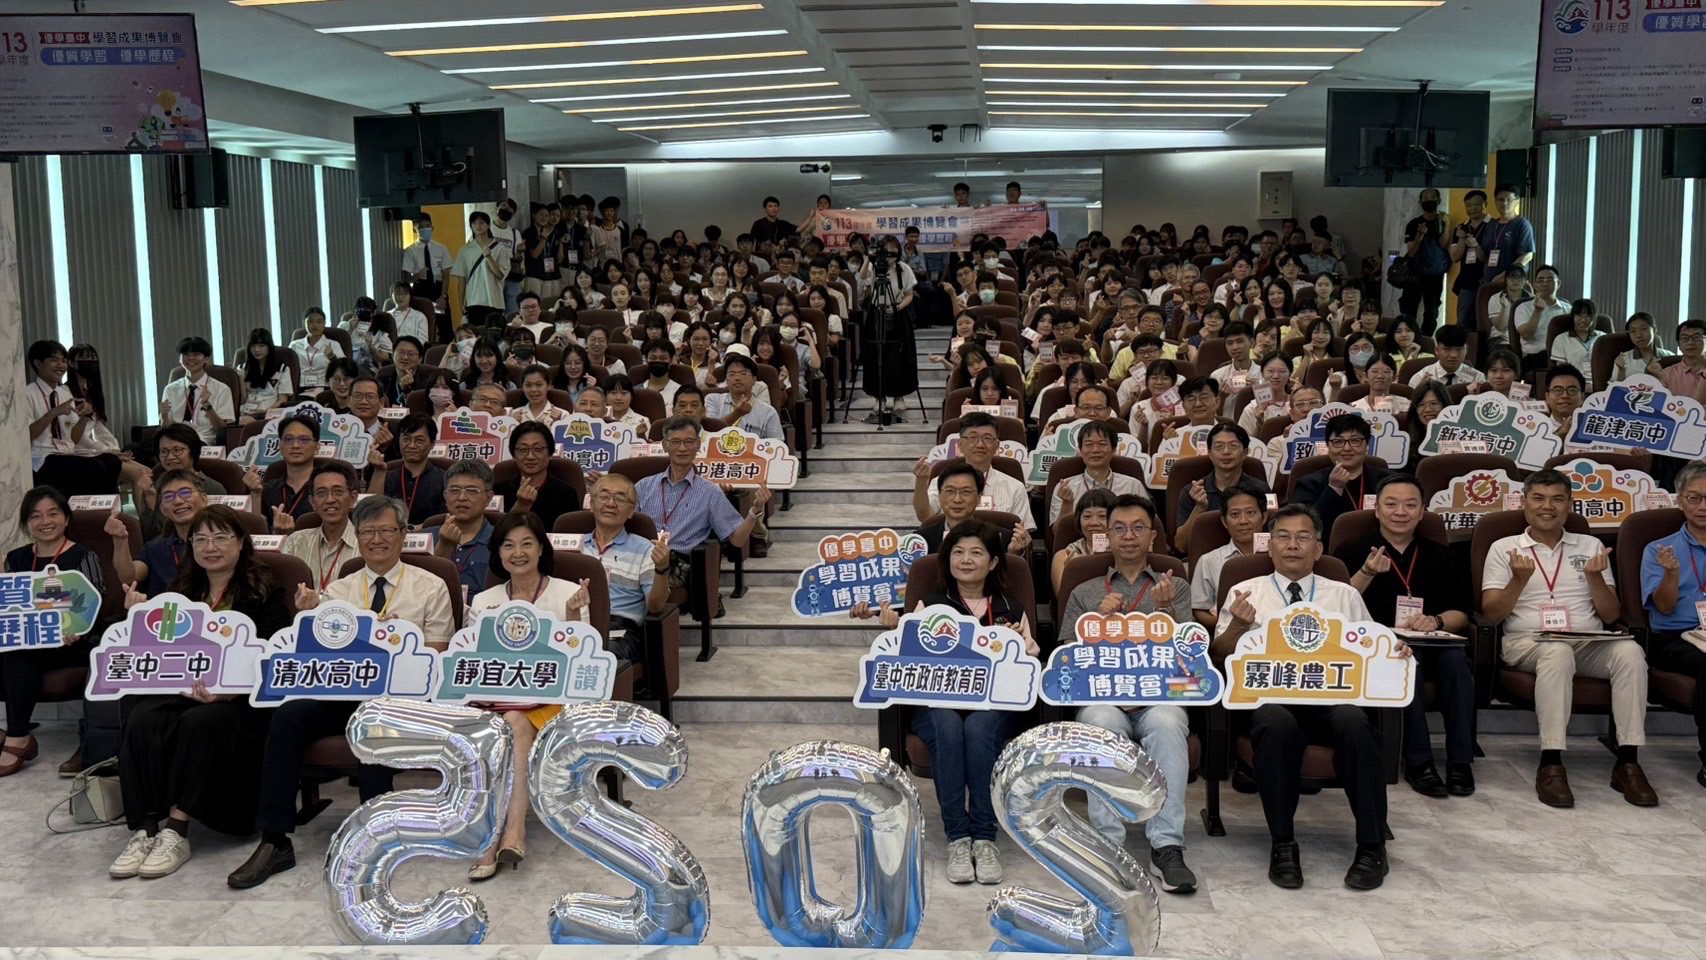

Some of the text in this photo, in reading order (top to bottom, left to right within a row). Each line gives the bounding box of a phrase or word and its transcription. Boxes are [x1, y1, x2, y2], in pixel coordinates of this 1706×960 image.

[1594, 0, 1631, 20] 113
[93, 32, 183, 44] 學習成果博覽會
[835, 217, 852, 230] 113
[876, 215, 959, 229] 學習成果博覽會
[1585, 415, 1666, 443] 龍津高中
[824, 535, 894, 556] 優學臺中
[818, 557, 900, 586] 學習成果
[832, 582, 893, 609] 博覽會
[1083, 619, 1170, 639] 優學臺中
[106, 652, 211, 680] 臺中二中
[1073, 647, 1174, 670] 學習成果
[272, 659, 379, 688] 清水高中
[453, 659, 558, 689] 靜宜大學
[576, 664, 600, 692] 讚
[873, 662, 988, 695] 臺中市政府教育局
[1088, 674, 1163, 698] 博覽會
[1244, 661, 1354, 691] 霧峰農工
